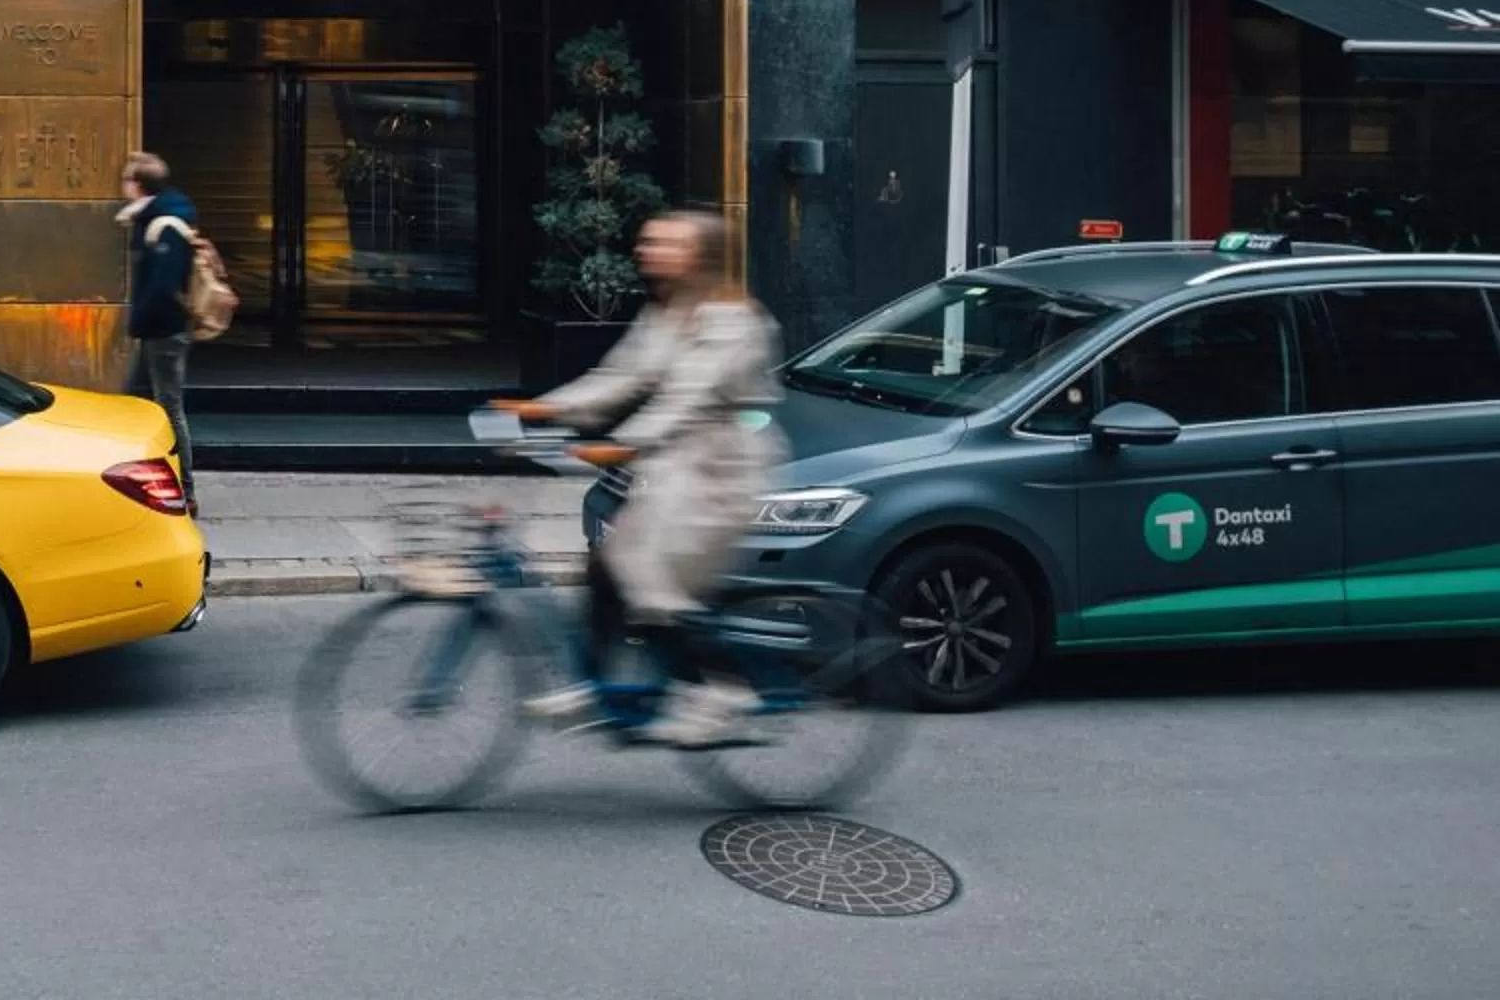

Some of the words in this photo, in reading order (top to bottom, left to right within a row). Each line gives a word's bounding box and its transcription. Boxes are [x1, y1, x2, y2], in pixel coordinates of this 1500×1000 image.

[30, 47, 59, 65] TO
[1214, 503, 1292, 526] Dantaxi
[1216, 528, 1265, 546] 4x48
